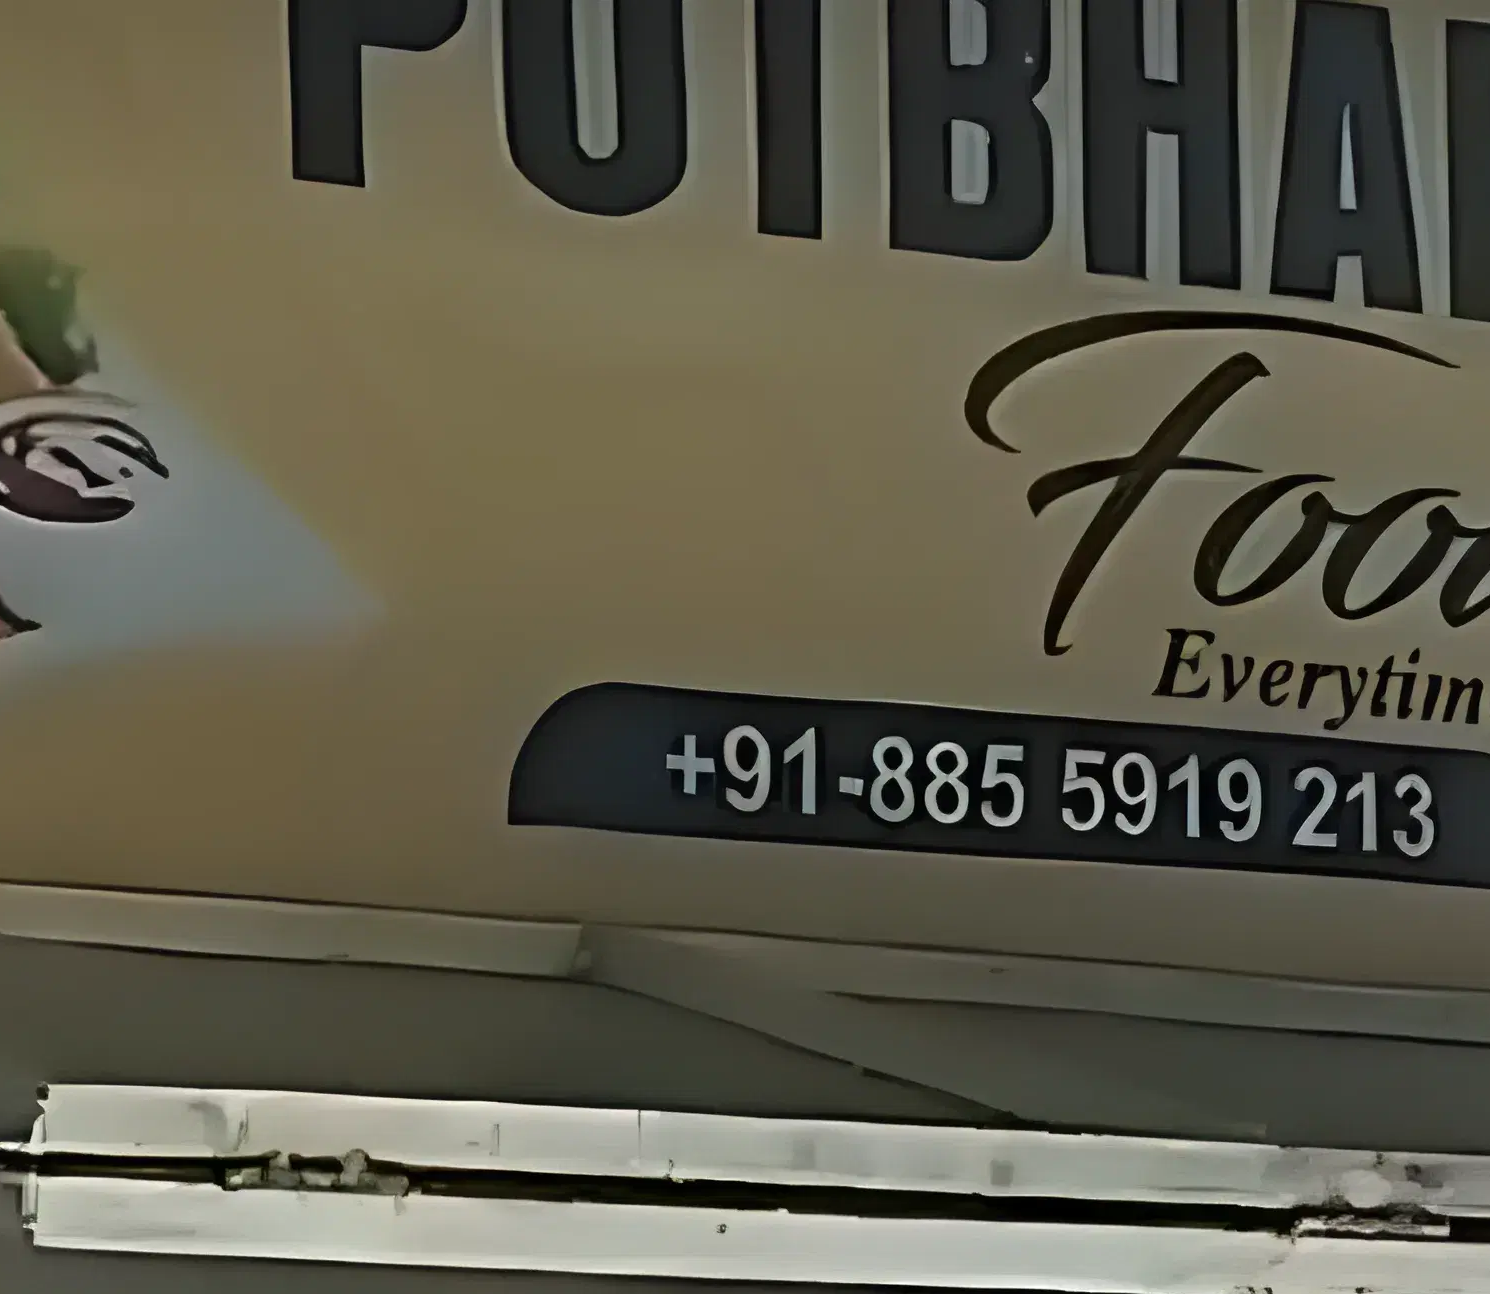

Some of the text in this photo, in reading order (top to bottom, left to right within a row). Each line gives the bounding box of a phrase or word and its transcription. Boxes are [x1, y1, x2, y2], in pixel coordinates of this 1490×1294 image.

[666, 725, 1435, 857] +91-885 5919 213
